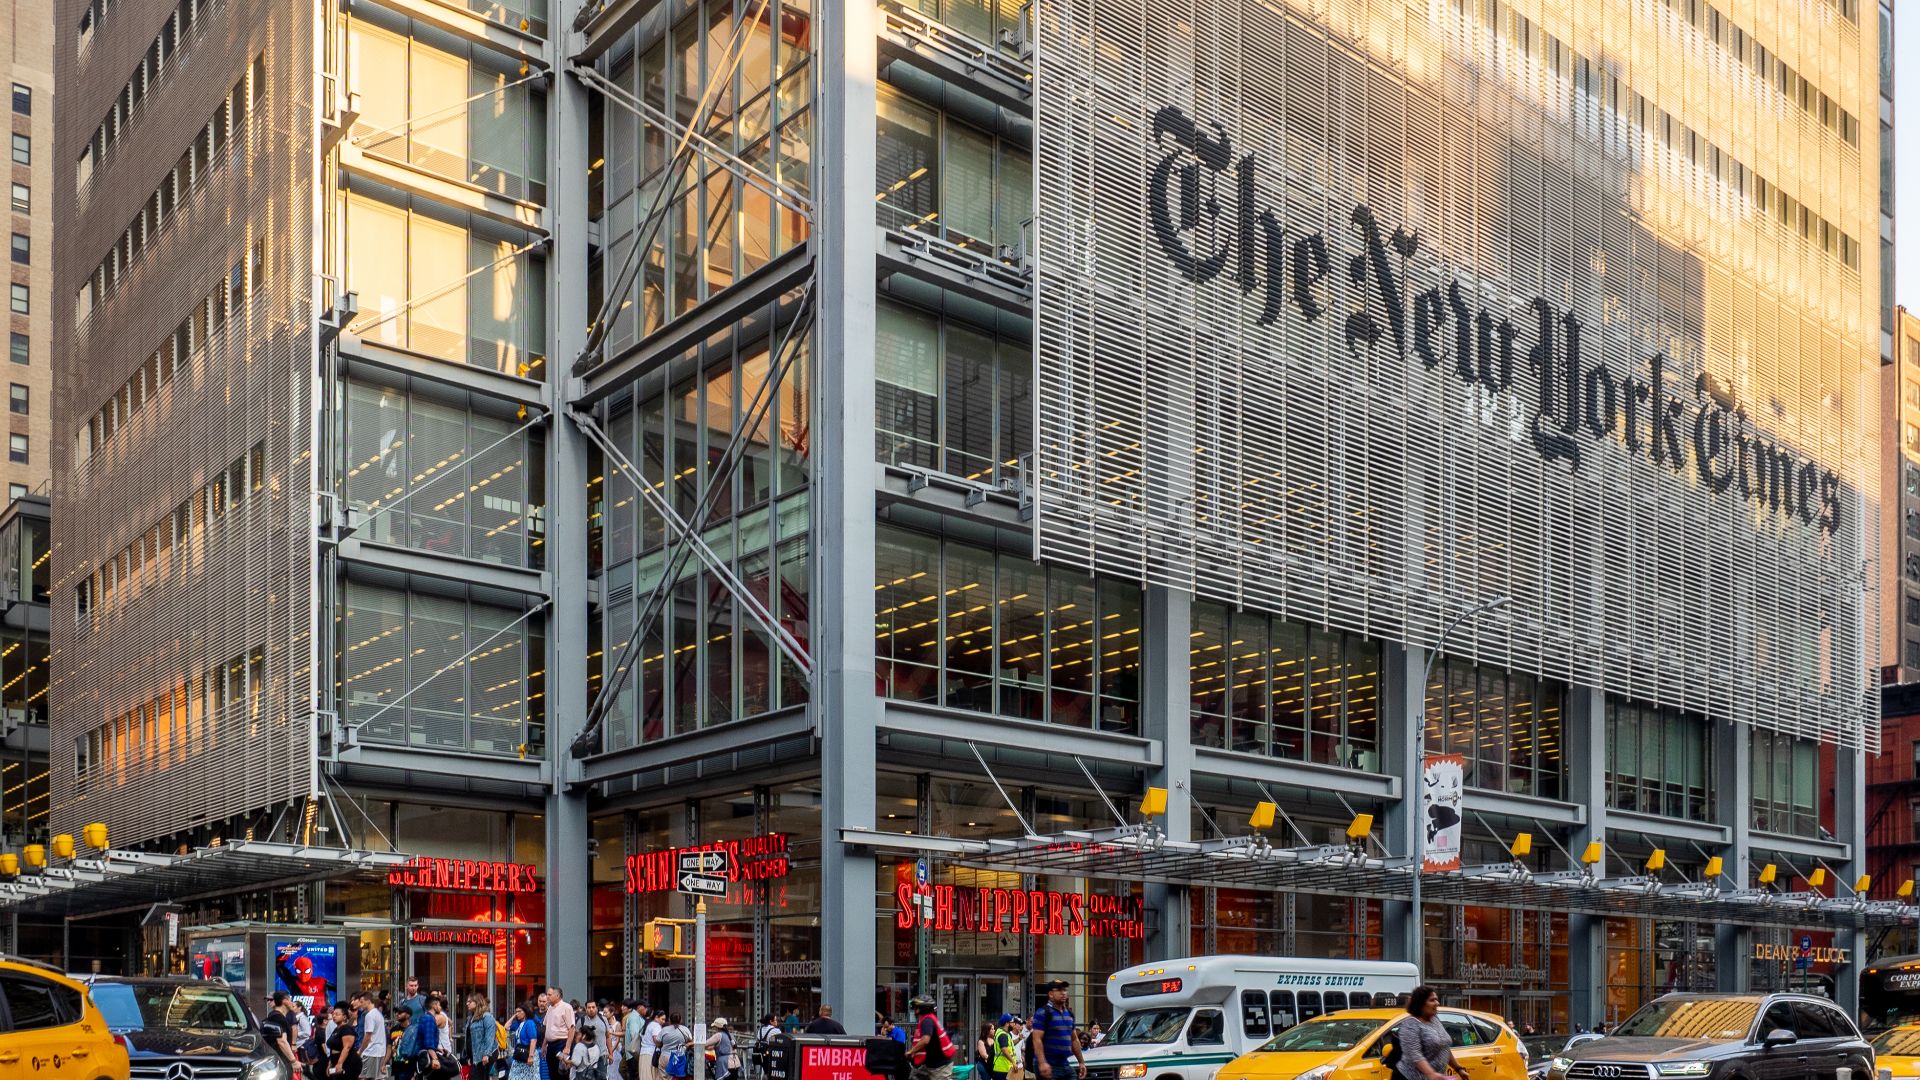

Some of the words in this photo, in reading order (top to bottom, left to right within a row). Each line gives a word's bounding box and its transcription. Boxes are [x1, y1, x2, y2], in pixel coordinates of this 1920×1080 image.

[1150, 104, 1332, 326] The
[1345, 203, 1518, 396] New
[1529, 296, 1686, 473] York
[1693, 371, 1843, 534] Times
[743, 833, 787, 857] QUALITY
[626, 838, 740, 895] SCHNI'S
[686, 857, 700, 867] ONE
[705, 856, 720, 867] WAY
[743, 857, 789, 881] KITCHEN
[685, 878, 700, 888] ONE
[706, 880, 721, 890] WAY
[1090, 894, 1144, 915] QUALITY
[413, 930, 454, 943] QUALITY
[456, 932, 495, 945] KITCHEN
[1090, 919, 1144, 939] KITCHEN
[1756, 943, 1789, 961] DEAN
[1791, 946, 1799, 961] &
[1810, 946, 1845, 963] ELUCA
[1277, 974, 1322, 986] EXPRESS
[1325, 976, 1365, 987] SERVICE
